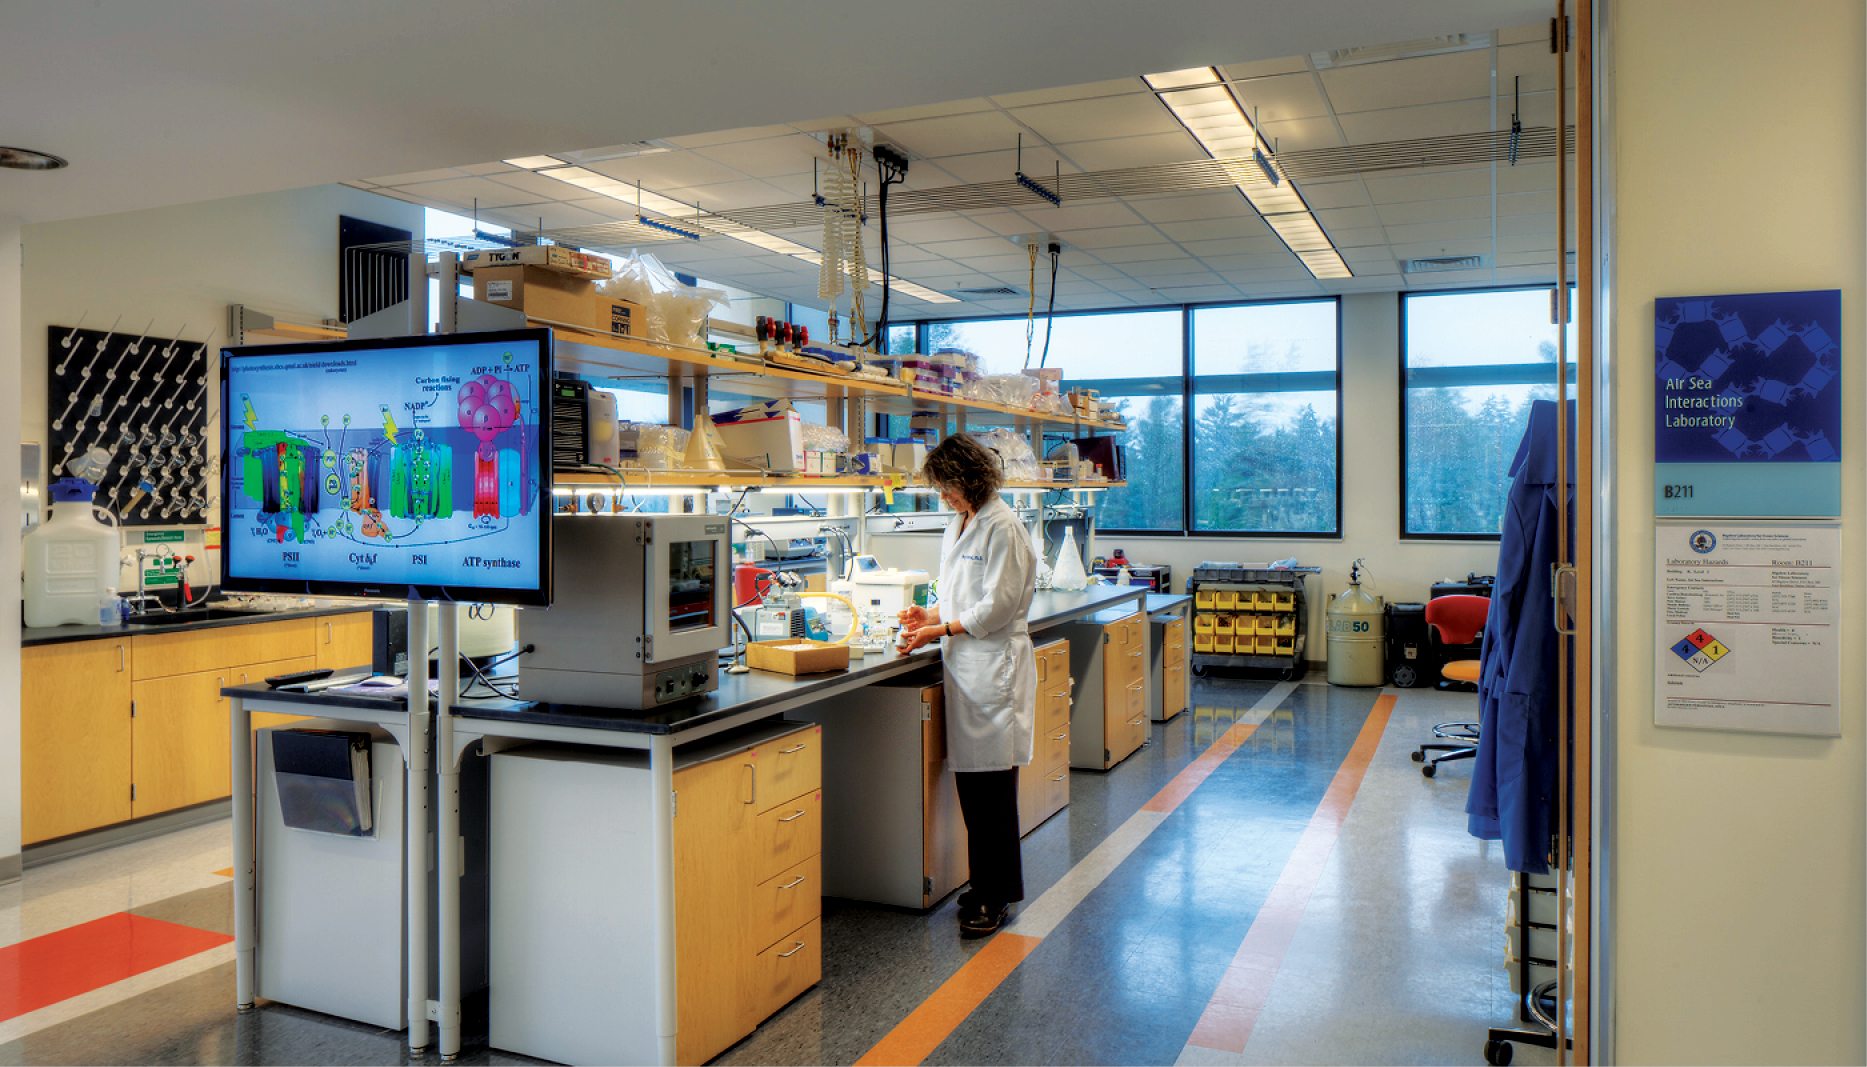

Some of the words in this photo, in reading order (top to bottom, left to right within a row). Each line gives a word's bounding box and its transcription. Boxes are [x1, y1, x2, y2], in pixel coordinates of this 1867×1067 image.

[514, 363, 531, 372] ATP
[415, 376, 440, 384] Carbon
[1666, 378, 1684, 390] Air
[1688, 377, 1712, 389] Sea
[422, 383, 452, 391] reactions
[1665, 395, 1743, 409] Interactions
[1666, 414, 1735, 429] Laboratory
[1664, 485, 1694, 498] B211
[282, 552, 300, 561] PSII
[349, 553, 364, 564] Cyt
[412, 555, 427, 565] PSI
[463, 557, 481, 567] ATP
[483, 557, 521, 570] synthase
[1666, 558, 1701, 566] Laboratory
[1702, 558, 1729, 566] Hazards
[1353, 621, 1369, 632] 50
[1696, 635, 1704, 643] 4
[1713, 646, 1718, 654] 1
